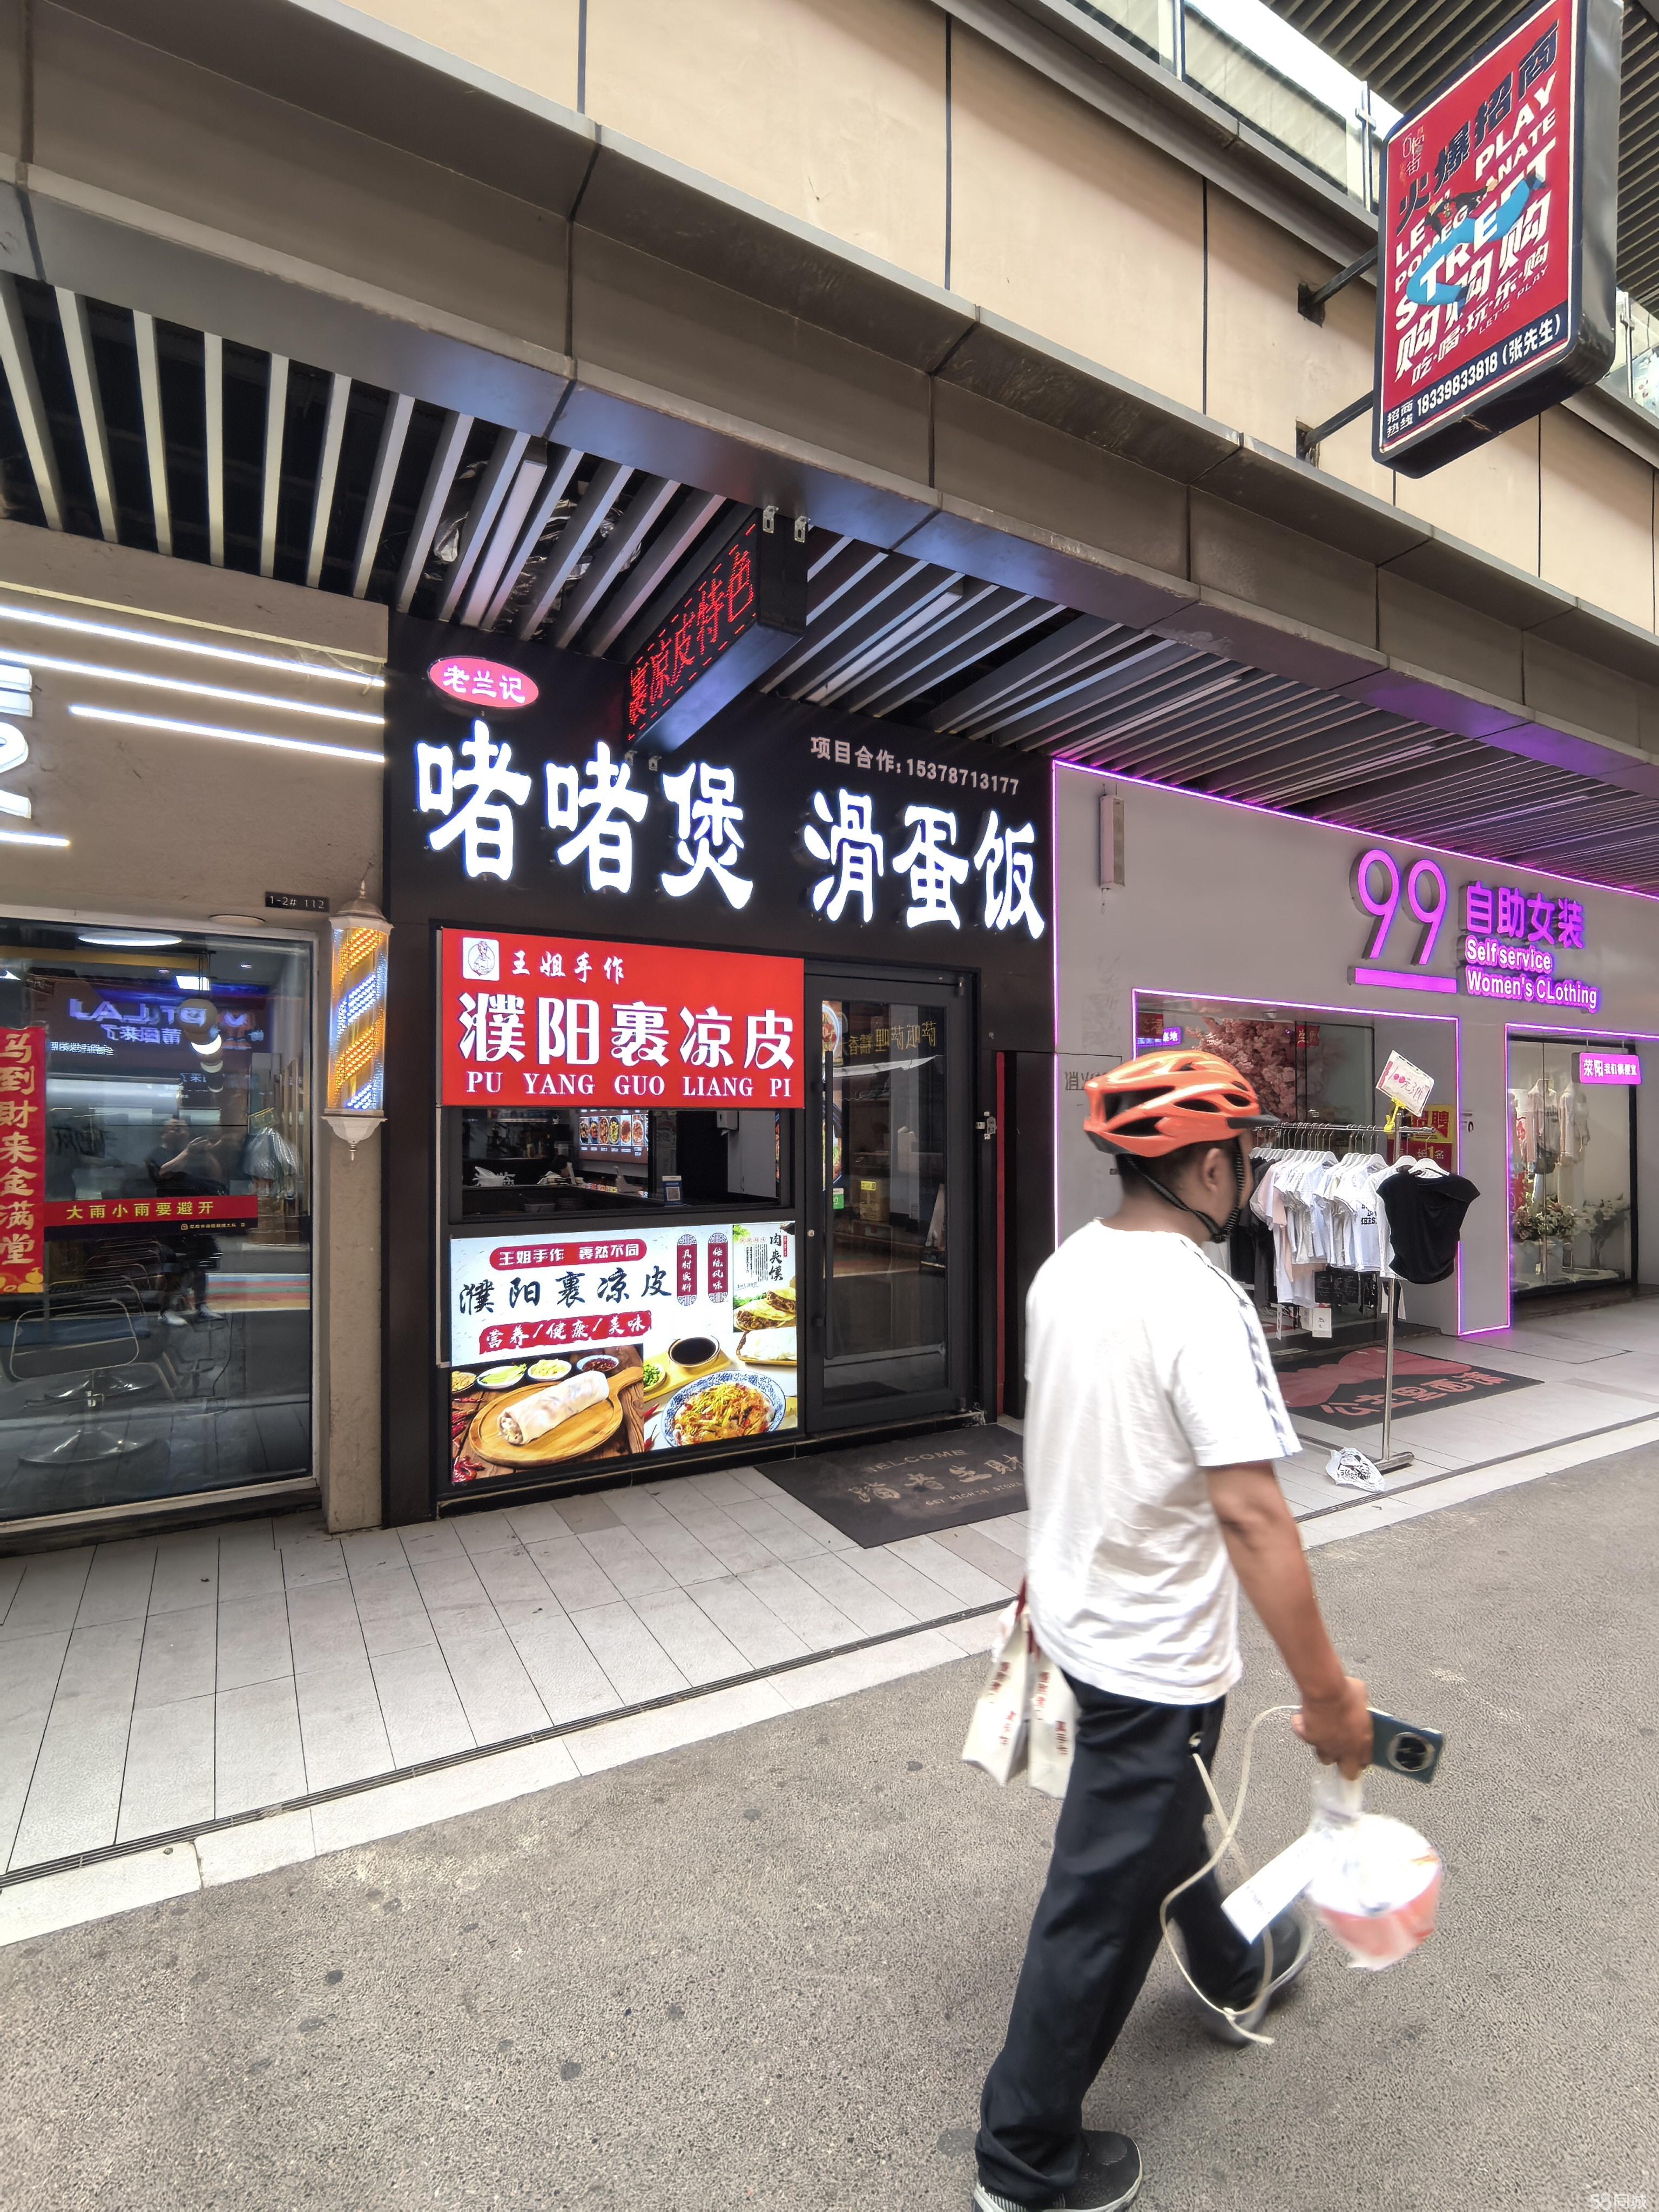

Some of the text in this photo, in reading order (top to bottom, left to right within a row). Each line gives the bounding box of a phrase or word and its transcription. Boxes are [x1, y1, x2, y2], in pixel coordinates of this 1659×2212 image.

[1396, 19, 1559, 237] 火爆招商
[1475, 70, 1557, 181] PLAY
[1516, 265, 1548, 300] PLAY
[1417, 353, 1499, 416] 18339833818
[441, 664, 527, 704] 老兰记
[416, 718, 1045, 940] 啫啫煲 滑蛋饭
[305, 899, 325, 909] 112
[1357, 848, 1447, 966] 99
[1466, 881, 1585, 949] 自助女装
[511, 949, 625, 985] 王姐手作
[1466, 939, 1552, 972] Self service
[1467, 969, 1533, 997] Women's
[458, 992, 795, 1070] 濮阳裹凉皮
[466, 1071, 792, 1098] PU YANG GUO LIANG PI
[66, 1201, 214, 1220] 大雨小雨要避开
[499, 1248, 565, 1266] 王姐手作
[459, 1265, 672, 1316] 濮阳裹凉皮
